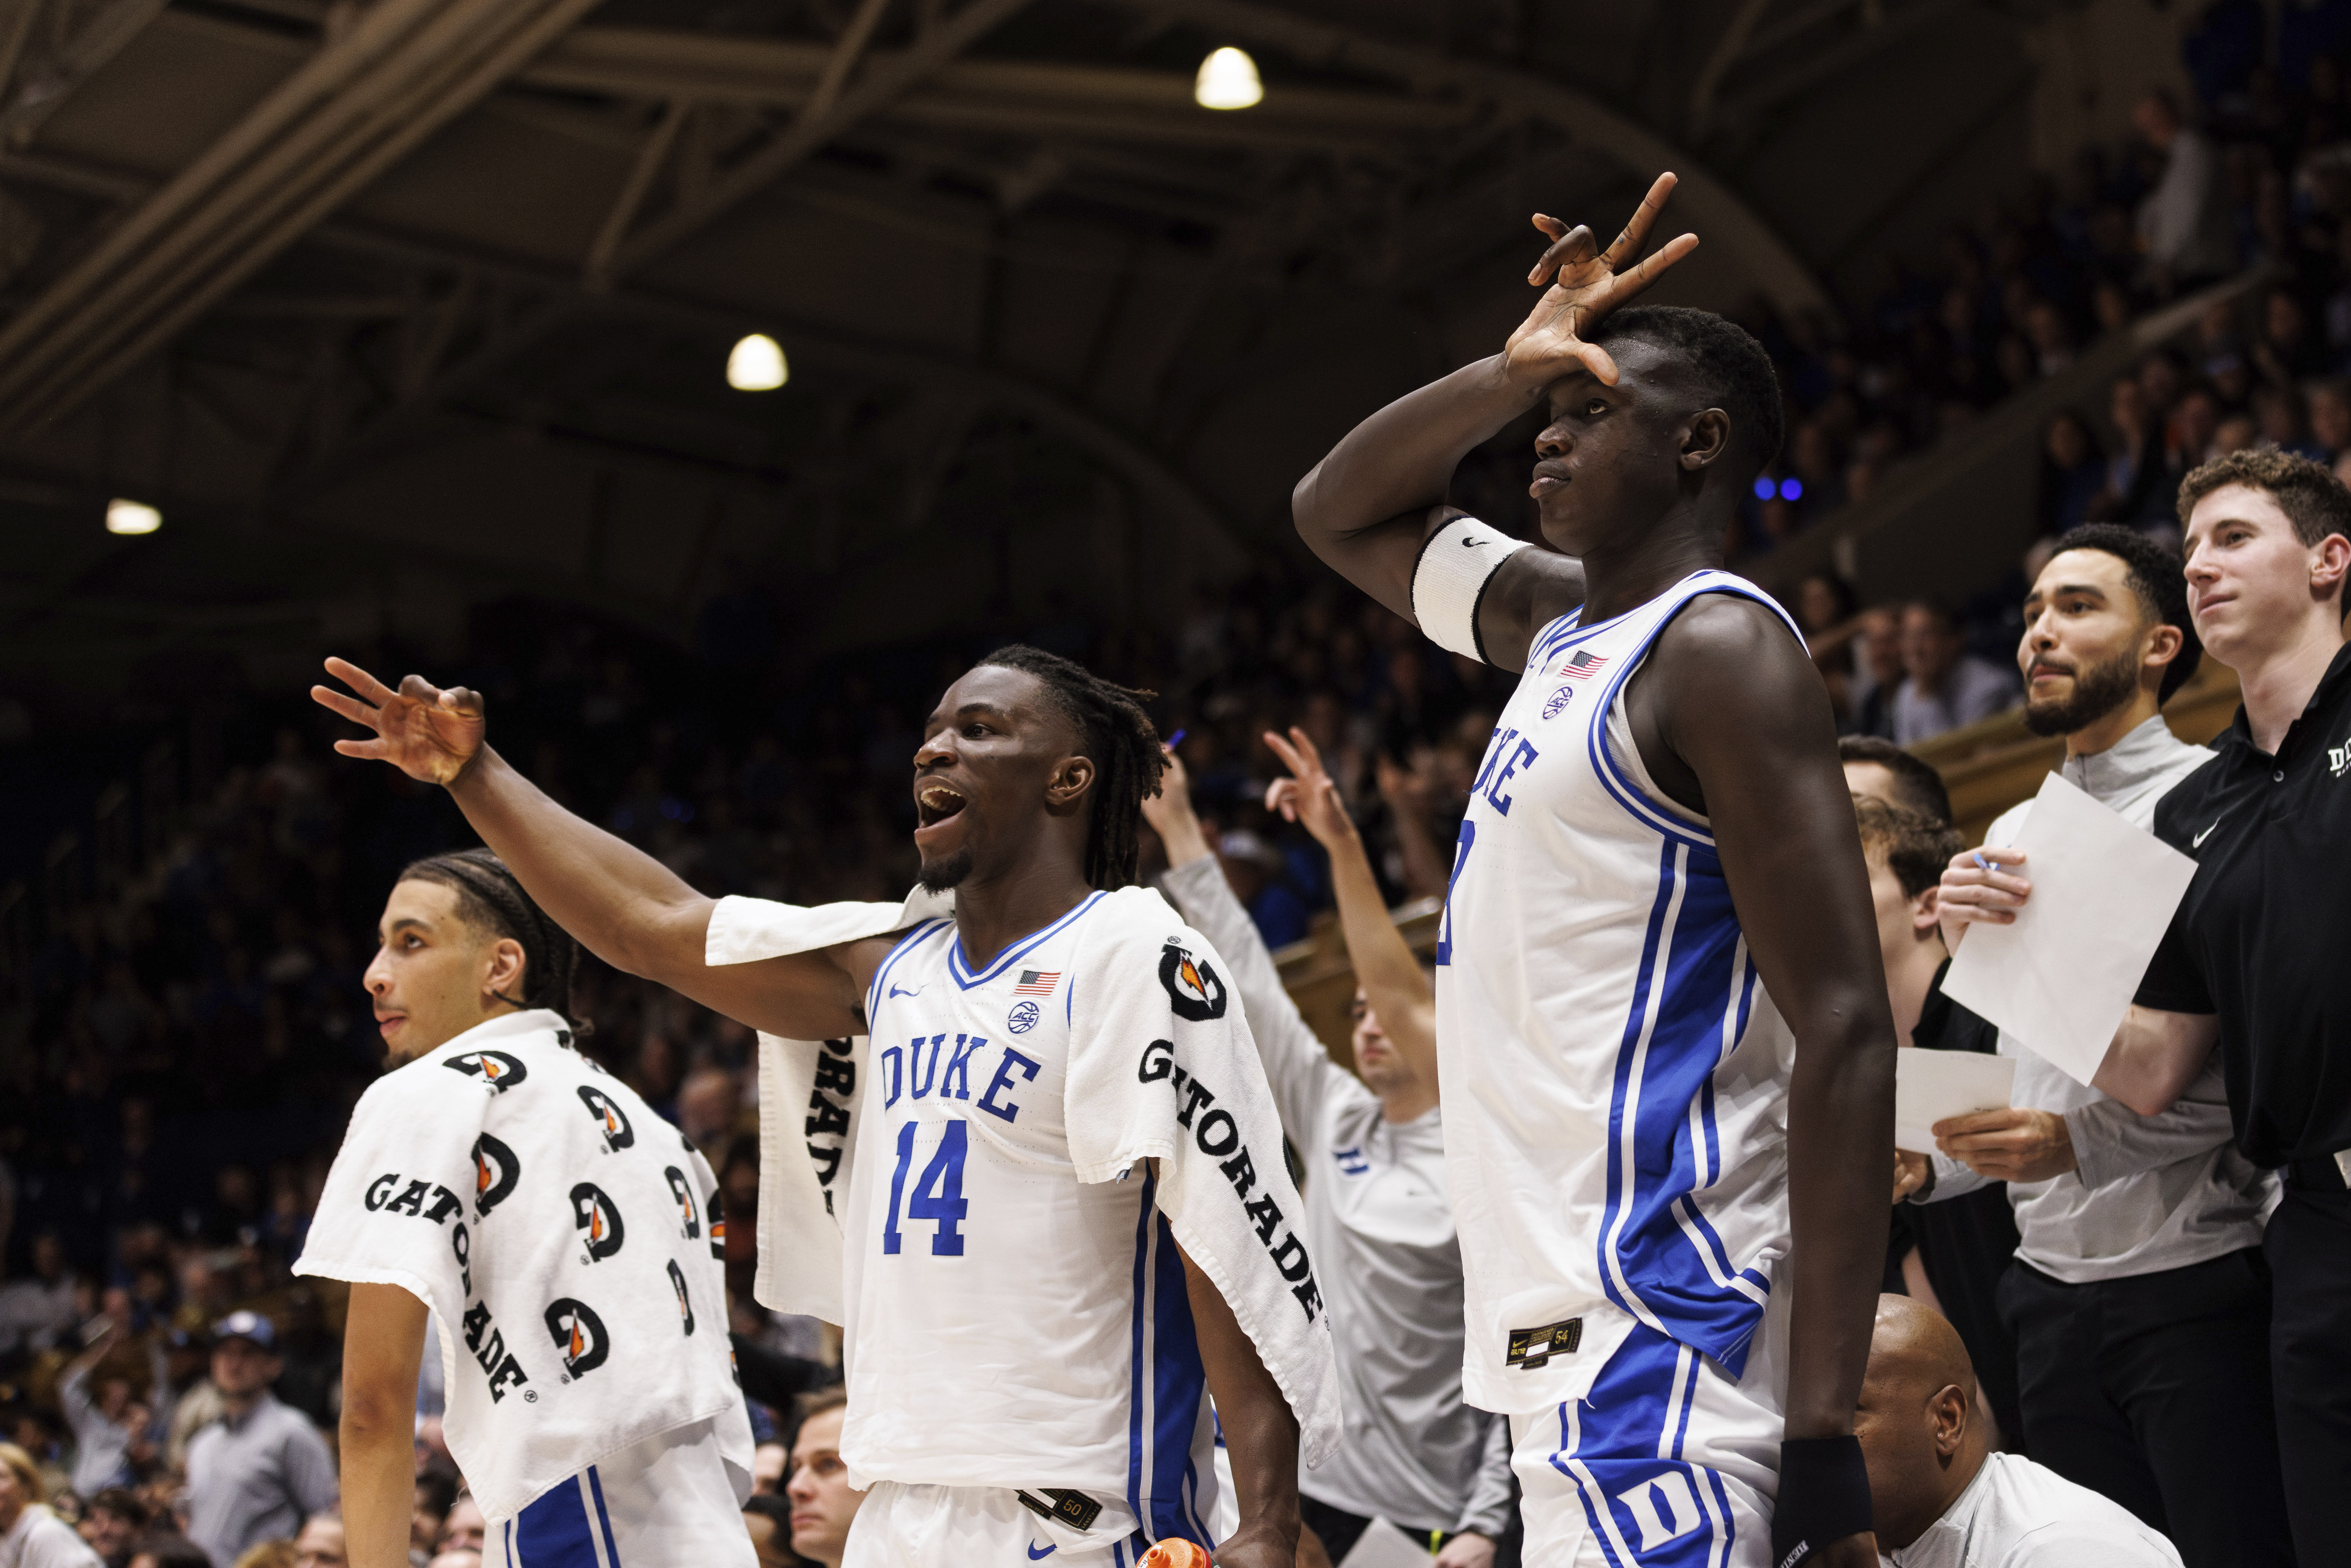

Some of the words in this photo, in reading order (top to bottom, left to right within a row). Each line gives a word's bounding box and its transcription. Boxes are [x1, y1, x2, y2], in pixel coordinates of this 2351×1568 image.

[1550, 697, 1569, 706] ACC
[1012, 1012, 1039, 1020] ACC
[881, 1033, 1042, 1123] DUKE
[883, 1119, 968, 1256] 14
[1555, 1329, 1568, 1344] 54
[1063, 1499, 1082, 1516] 50
